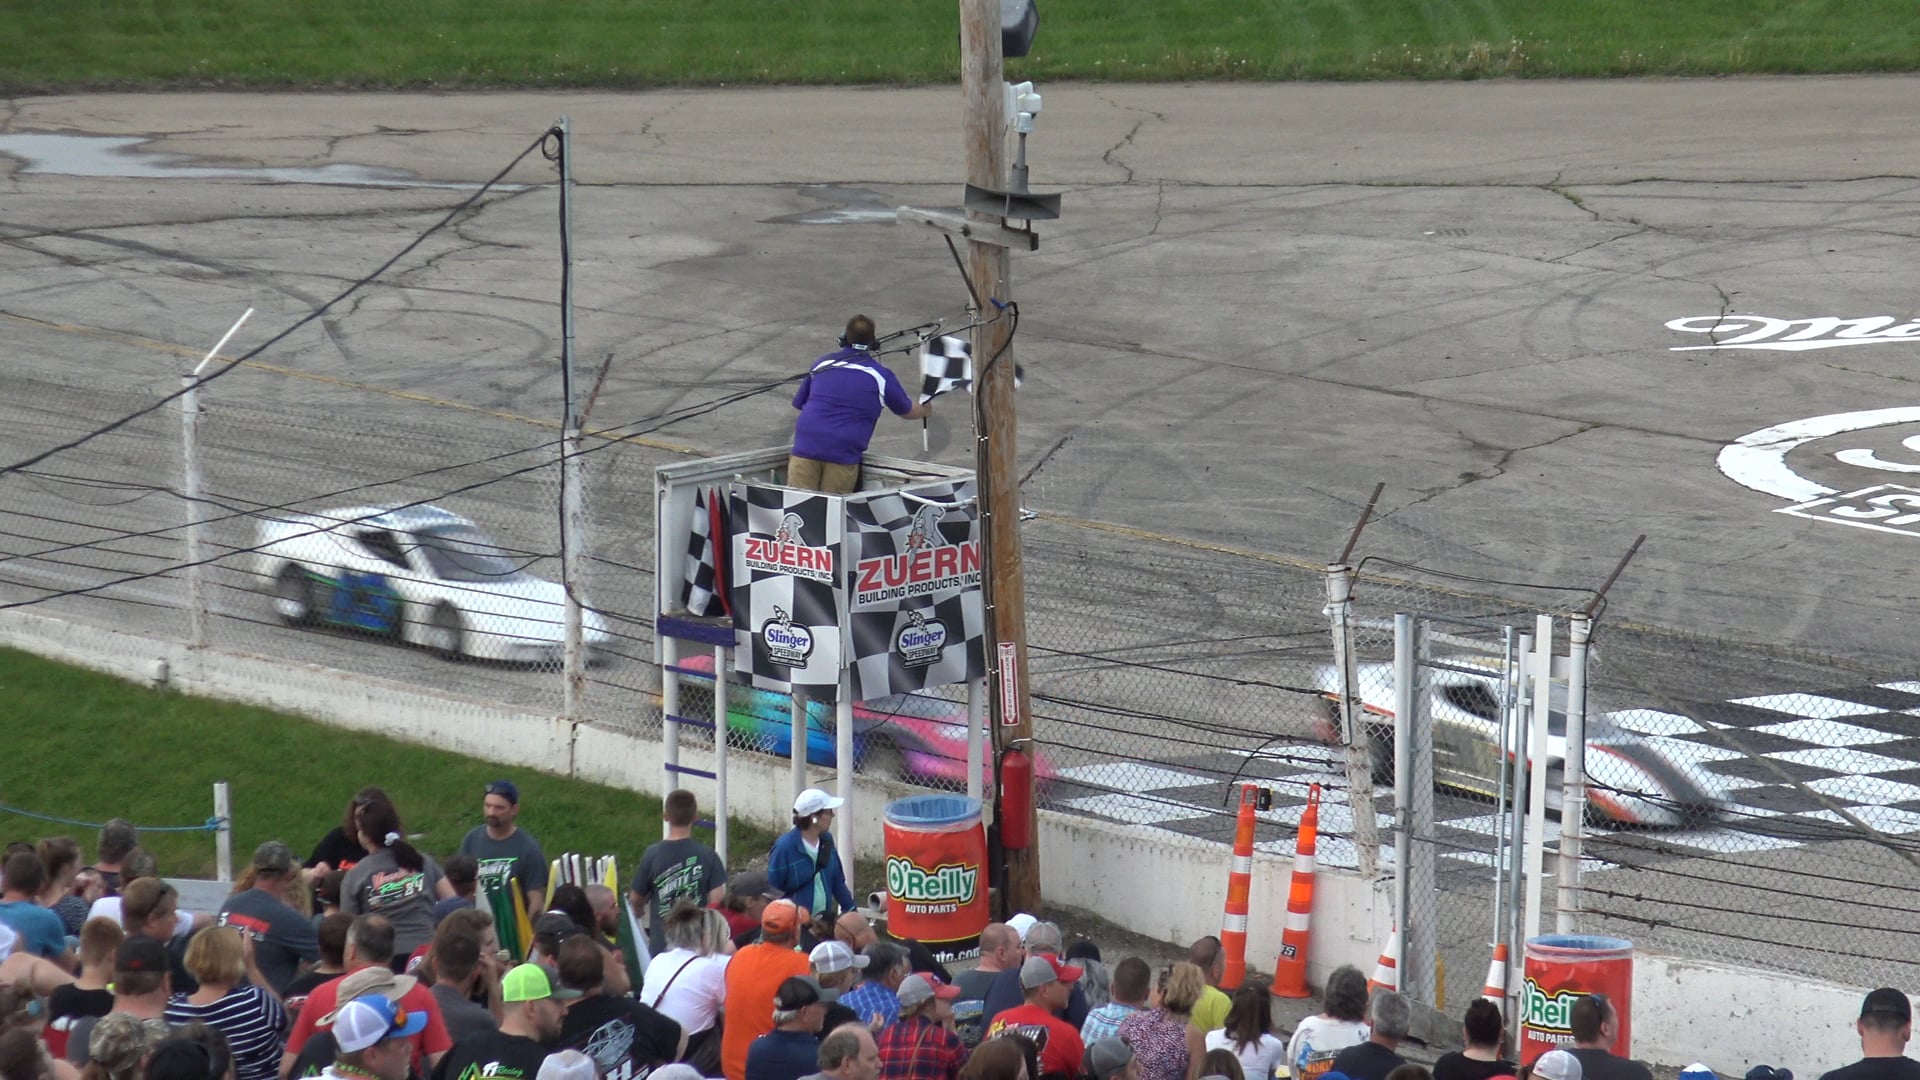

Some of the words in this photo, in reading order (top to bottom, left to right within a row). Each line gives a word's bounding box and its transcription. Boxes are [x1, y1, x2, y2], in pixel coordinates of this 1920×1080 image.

[745, 538, 832, 572] ZUERN
[746, 559, 778, 571] BUILDING
[858, 543, 980, 592] ZUERN
[858, 586, 906, 605] BUILDING
[767, 628, 809, 649] Slinger
[901, 630, 944, 651] Slinger
[773, 647, 802, 659] SPEEDWAY
[907, 647, 939, 660] SPEEDWAY
[887, 858, 977, 900] O'Reilly
[905, 904, 927, 914] AUTO
[928, 904, 957, 914] PARTS
[1528, 1030, 1545, 1042] AUTO
